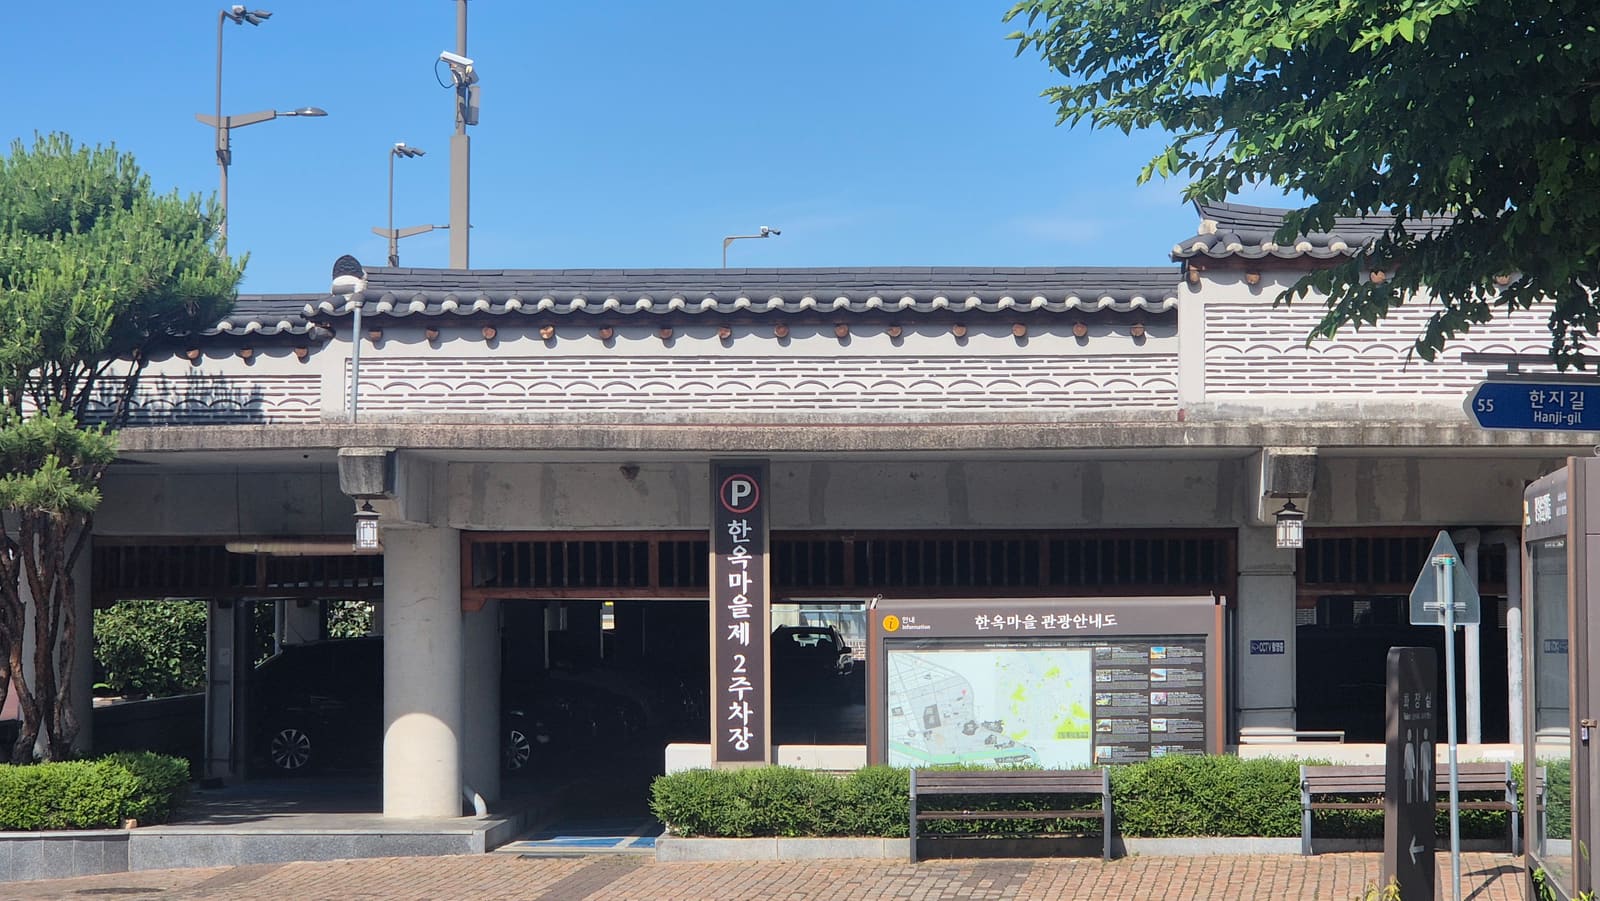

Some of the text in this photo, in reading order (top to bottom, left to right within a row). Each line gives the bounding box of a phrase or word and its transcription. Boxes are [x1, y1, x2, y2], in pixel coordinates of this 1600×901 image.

[1477, 399, 1494, 412] 55
[1529, 389, 1585, 410] 한지길
[1533, 411, 1582, 425] Hanji-gil
[731, 480, 751, 506] P
[902, 616, 915, 624] 안내
[974, 613, 1118, 630] 한옥마을 관광안내도
[727, 519, 753, 751] 한옥마을제 2주차장
[1259, 641, 1271, 653] CCTV
